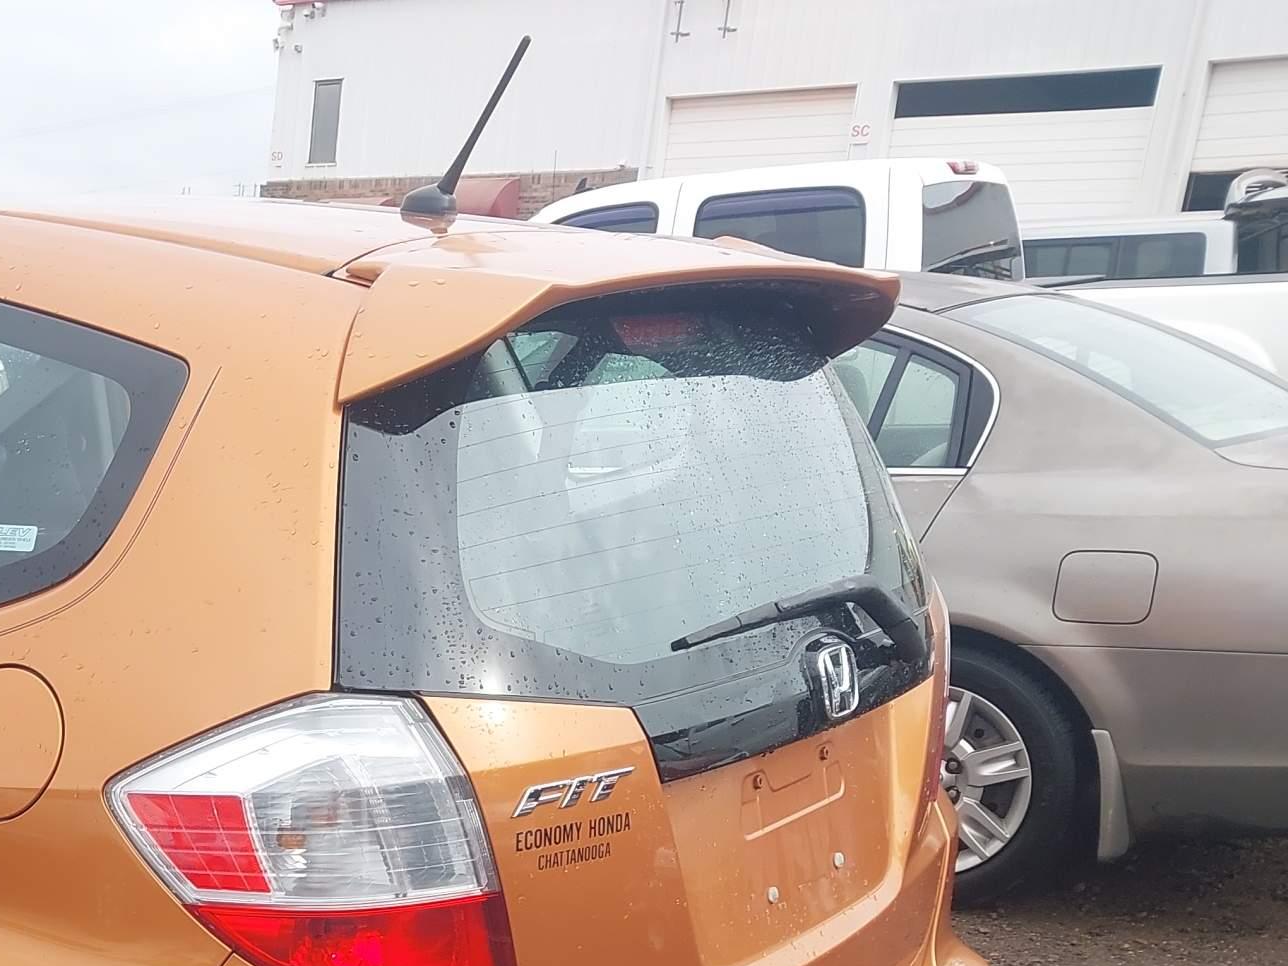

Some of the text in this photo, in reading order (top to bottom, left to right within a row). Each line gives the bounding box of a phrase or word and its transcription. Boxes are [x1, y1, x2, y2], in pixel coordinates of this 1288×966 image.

[851, 124, 871, 138] SC
[510, 764, 636, 819] FIT
[515, 812, 631, 853] ECONOMY HONDA
[538, 842, 611, 871] CHATTANOOGA
